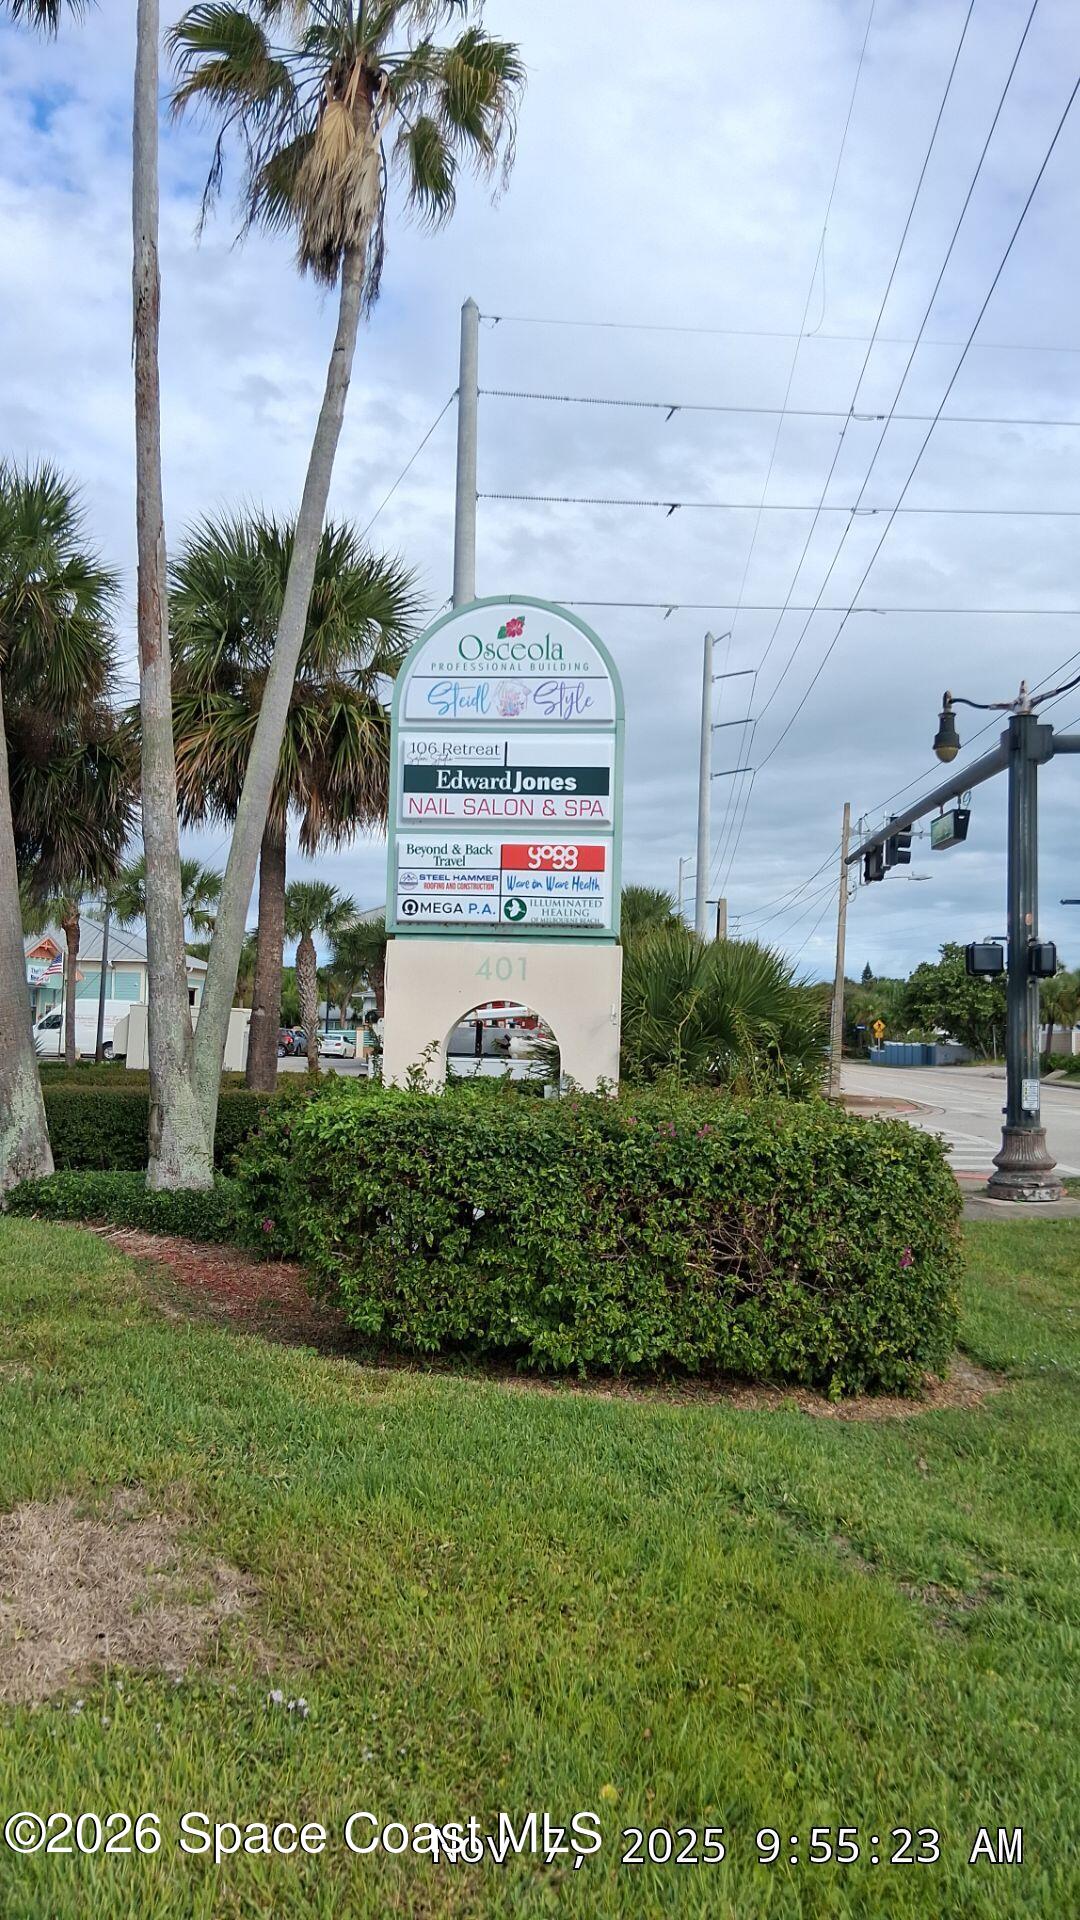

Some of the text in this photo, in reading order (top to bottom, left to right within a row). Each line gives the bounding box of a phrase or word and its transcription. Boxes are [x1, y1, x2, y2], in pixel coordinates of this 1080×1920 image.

[458, 633, 564, 661] Osceola
[431, 662, 590, 672] PROFESSIONAL BUILDING
[533, 680, 594, 720] Style
[409, 741, 500, 756] 106 Retreat
[408, 797, 604, 817] NAIL SALON & SPA
[406, 843, 493, 858] Beyond & Back
[433, 855, 466, 867] Travel
[453, 874, 499, 882] HAMMER
[507, 875, 600, 892] Wave on Wave Health
[446, 882, 456, 890] AND
[457, 882, 495, 890] CONSTRUCTION
[468, 903, 496, 915] P.A.
[530, 899, 602, 908] ILLUMINATED
[542, 908, 590, 917] HEALING
[475, 956, 528, 981] 401
